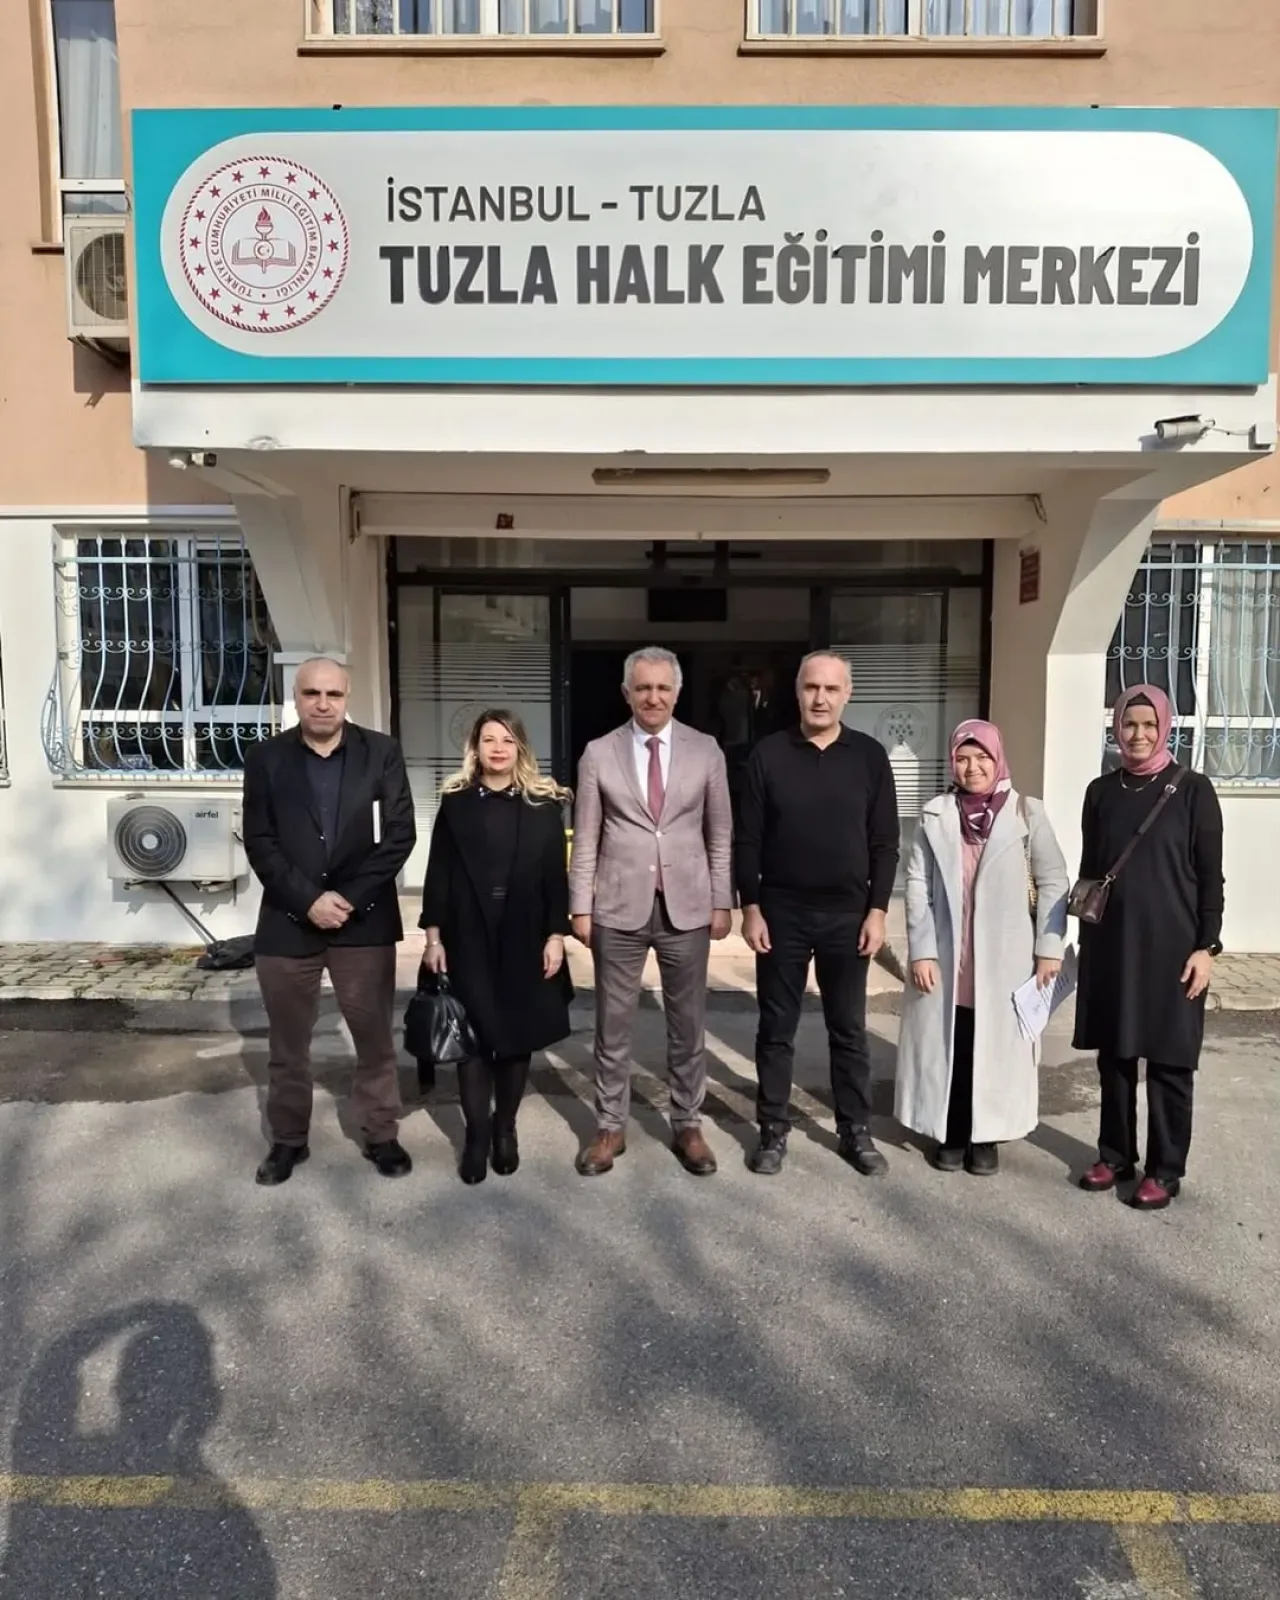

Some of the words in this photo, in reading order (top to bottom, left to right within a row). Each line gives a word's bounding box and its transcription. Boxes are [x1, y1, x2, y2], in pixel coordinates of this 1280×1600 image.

[210, 190, 257, 255] CUMHURİYETİ
[293, 203, 318, 241] EĞİTİM
[387, 176, 591, 223] İSTANBUL
[629, 185, 766, 222] TUZLA
[214, 259, 252, 297] TÜRKİYE
[276, 246, 318, 297] BAKANLIĞI
[380, 245, 558, 305] TUZLA
[576, 245, 725, 304] HALK
[742, 229, 946, 304] EĞİTİMİ
[963, 231, 1200, 306] MERKEZİ
[194, 810, 219, 819] airfel
